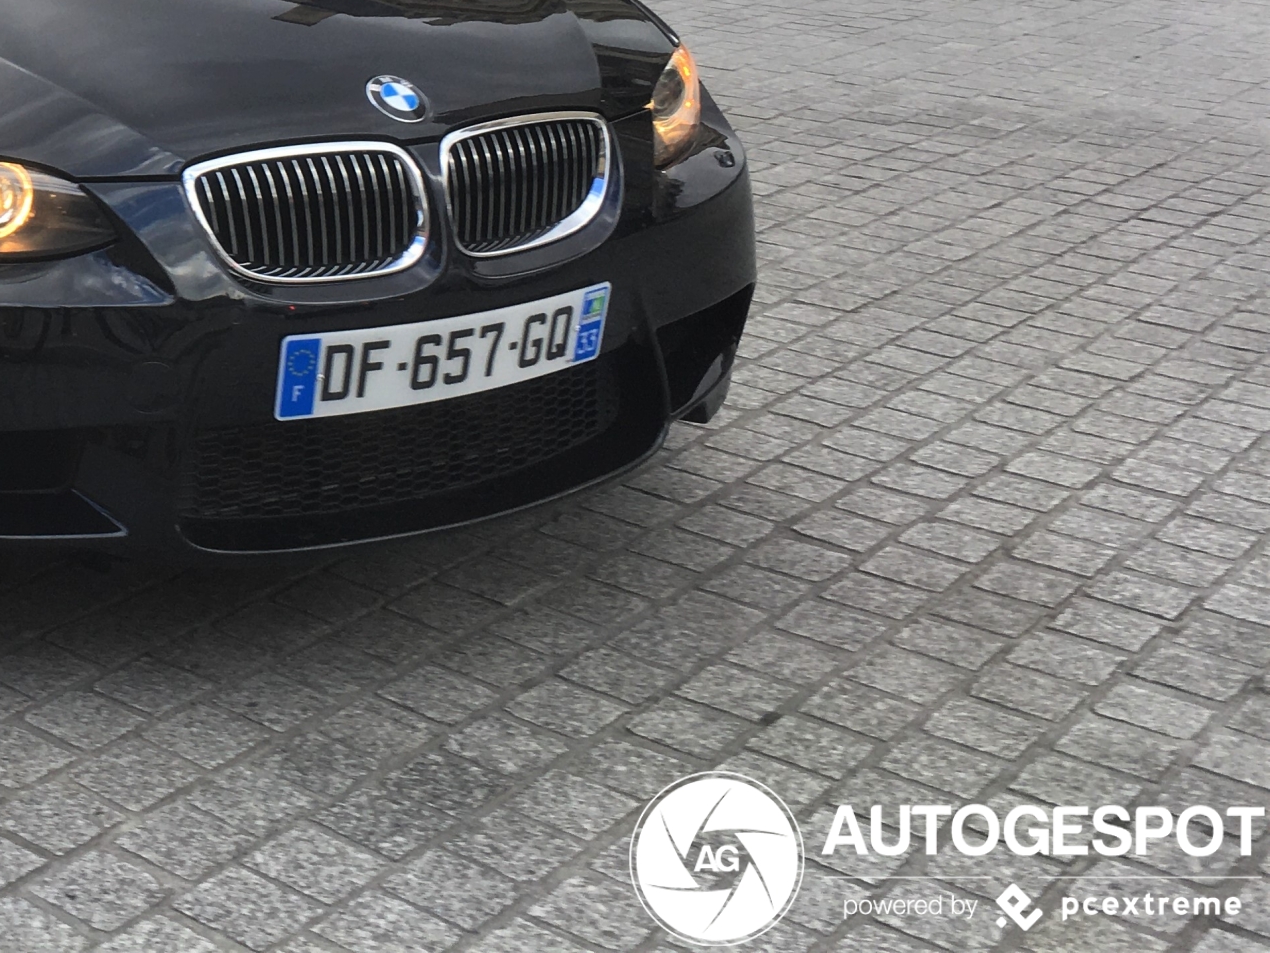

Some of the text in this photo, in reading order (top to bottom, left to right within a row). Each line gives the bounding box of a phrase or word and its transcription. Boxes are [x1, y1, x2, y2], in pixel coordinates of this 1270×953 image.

[320, 305, 574, 402] DF-657-GQ
[576, 328, 599, 355] 33
[291, 385, 301, 402] F
